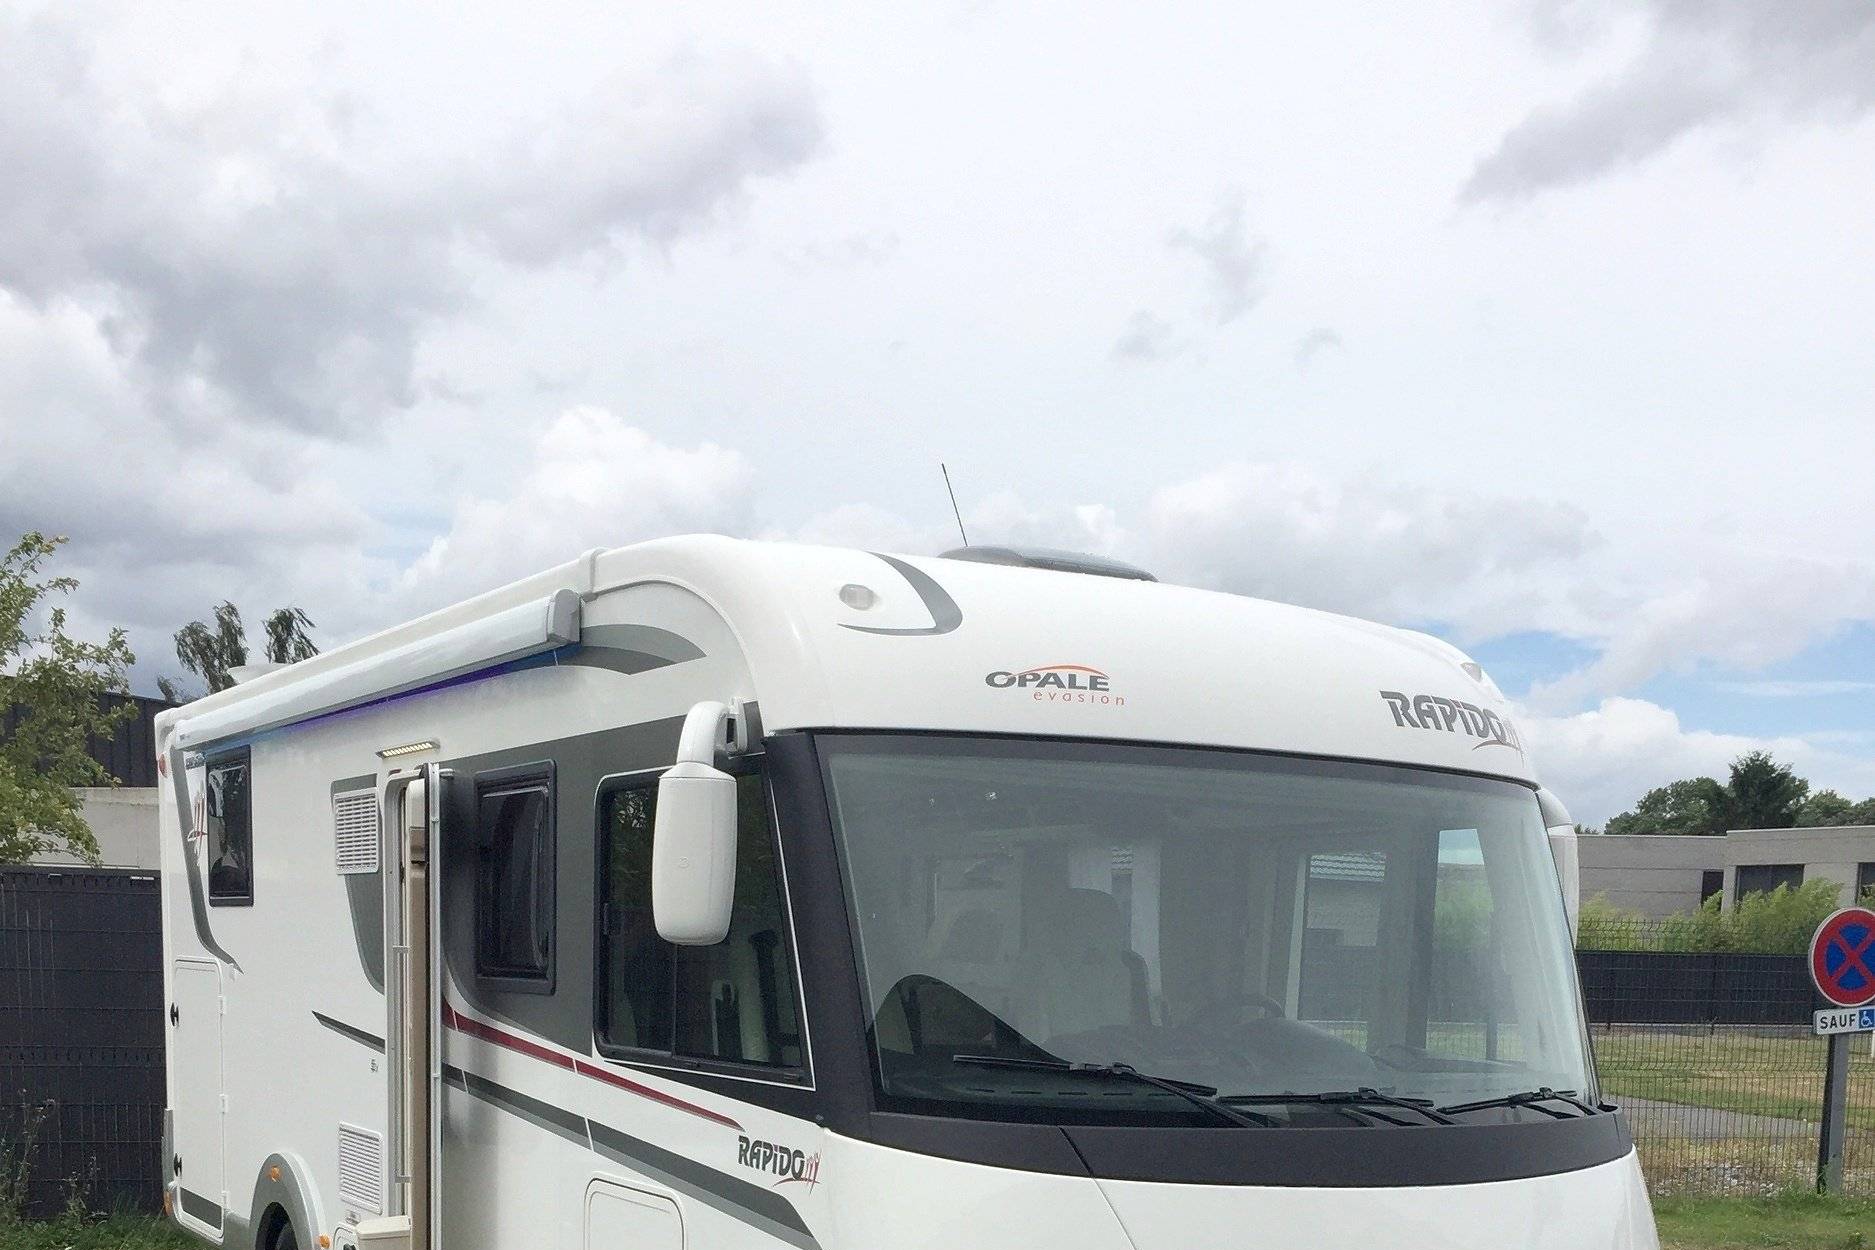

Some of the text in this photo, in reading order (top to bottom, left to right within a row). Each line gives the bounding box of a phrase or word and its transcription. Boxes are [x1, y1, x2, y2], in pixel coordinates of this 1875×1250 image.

[985, 671, 1109, 692] OPALE
[1033, 691, 1126, 706] evasion
[1819, 1013, 1857, 1030] SAUF
